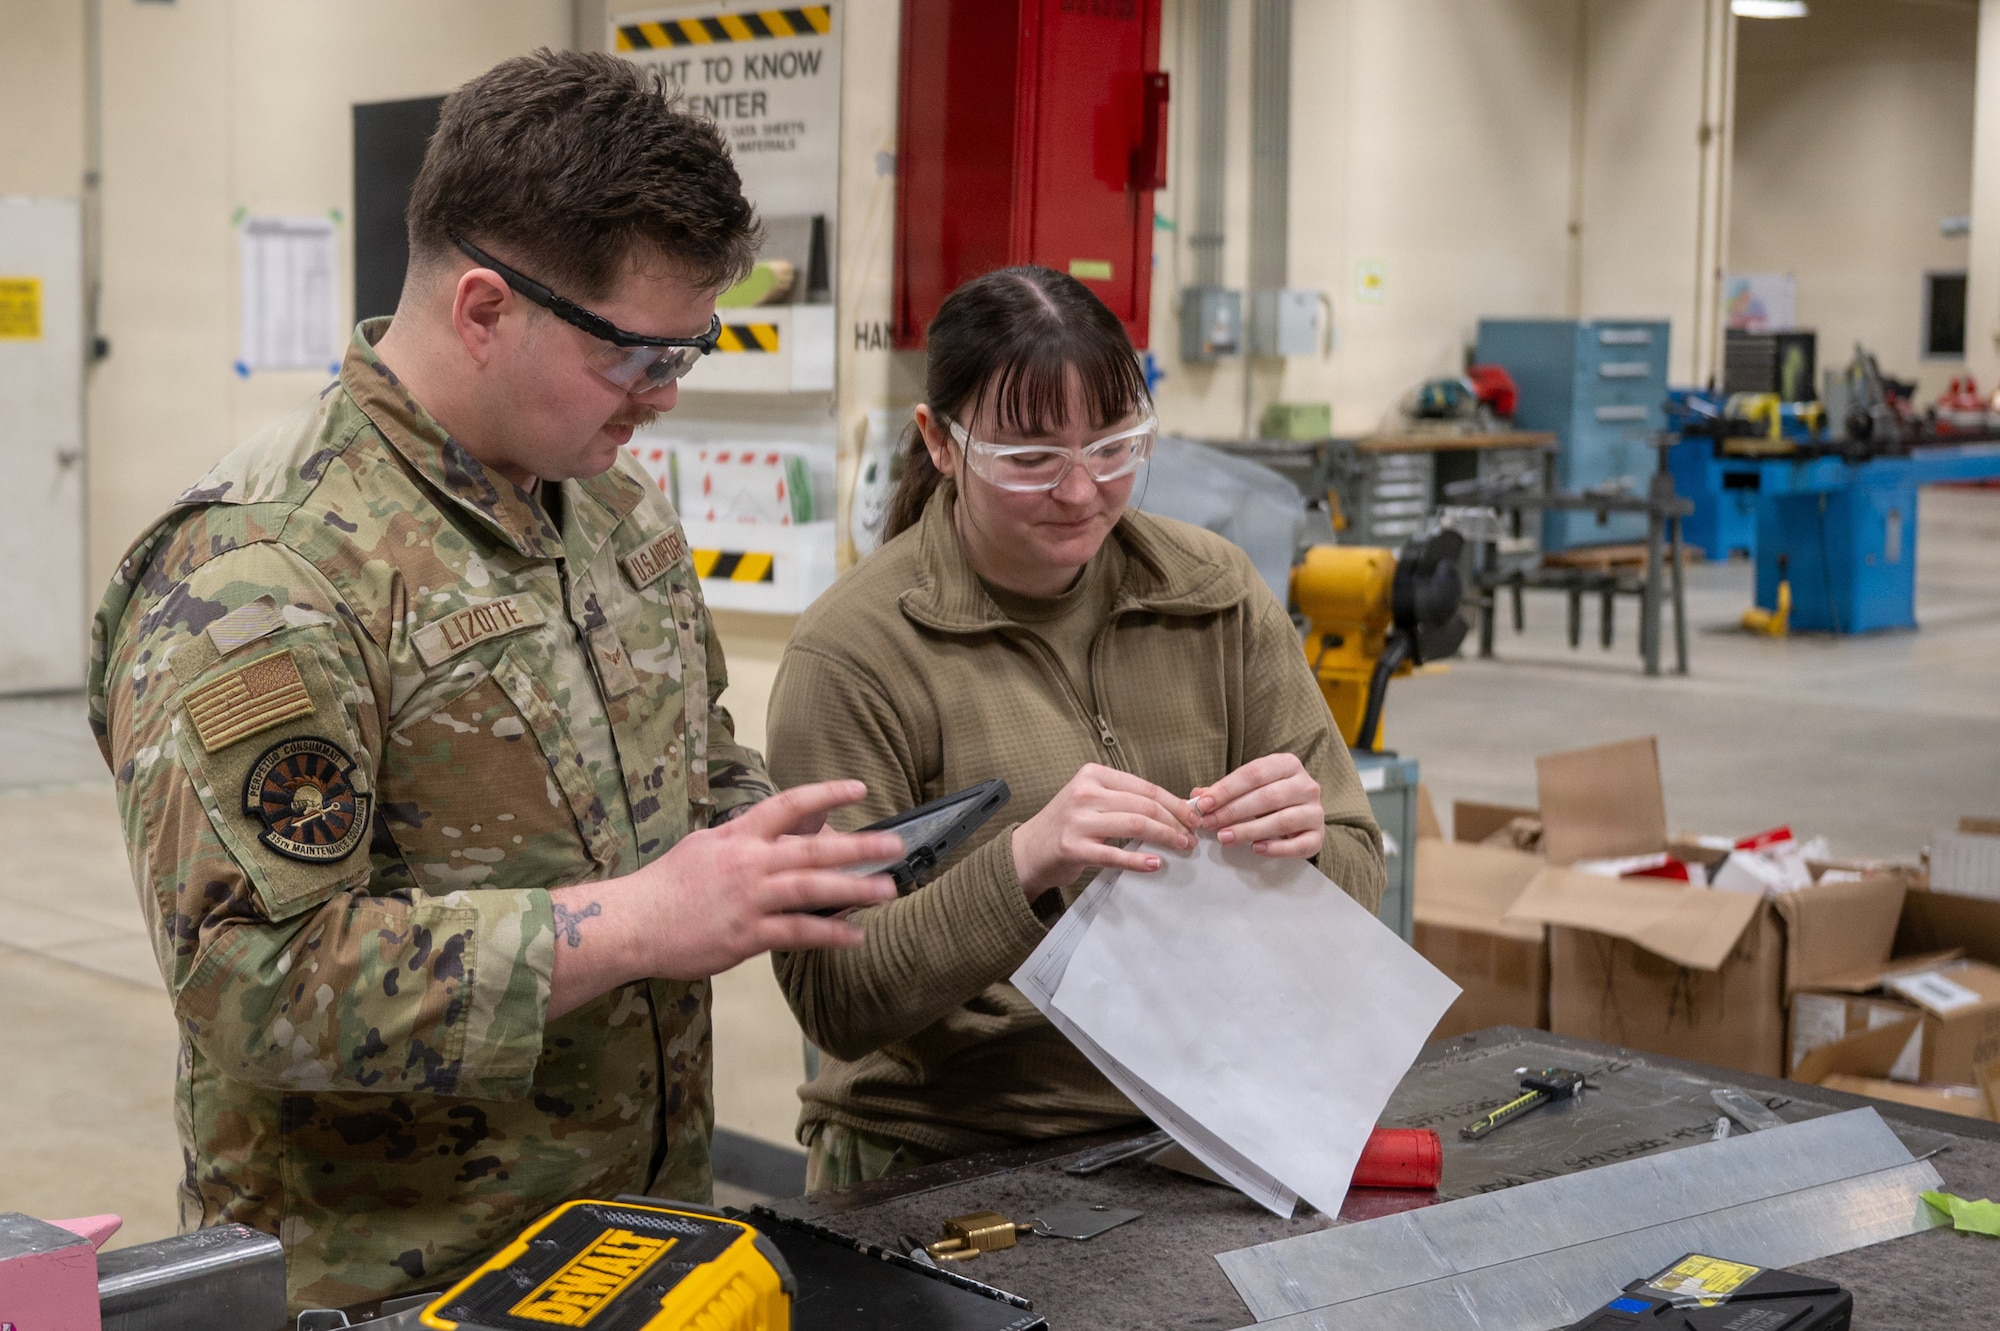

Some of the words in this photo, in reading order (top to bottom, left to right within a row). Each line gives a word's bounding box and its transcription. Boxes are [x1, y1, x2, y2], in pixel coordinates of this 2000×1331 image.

[702, 56, 733, 83] TO
[744, 48, 822, 80] KNOW
[687, 91, 767, 119] ENTER
[737, 138, 796, 152] MATERIALS
[761, 121, 804, 136] SHEETS
[439, 599, 523, 650] LIZOTTE
[250, 751, 280, 797] PERPETUO
[283, 740, 342, 763] CONSUMMATI
[292, 840, 349, 856] MAINTENANCE
[347, 799, 366, 843] SQUADRON
[515, 1229, 666, 1325] DEWALT
